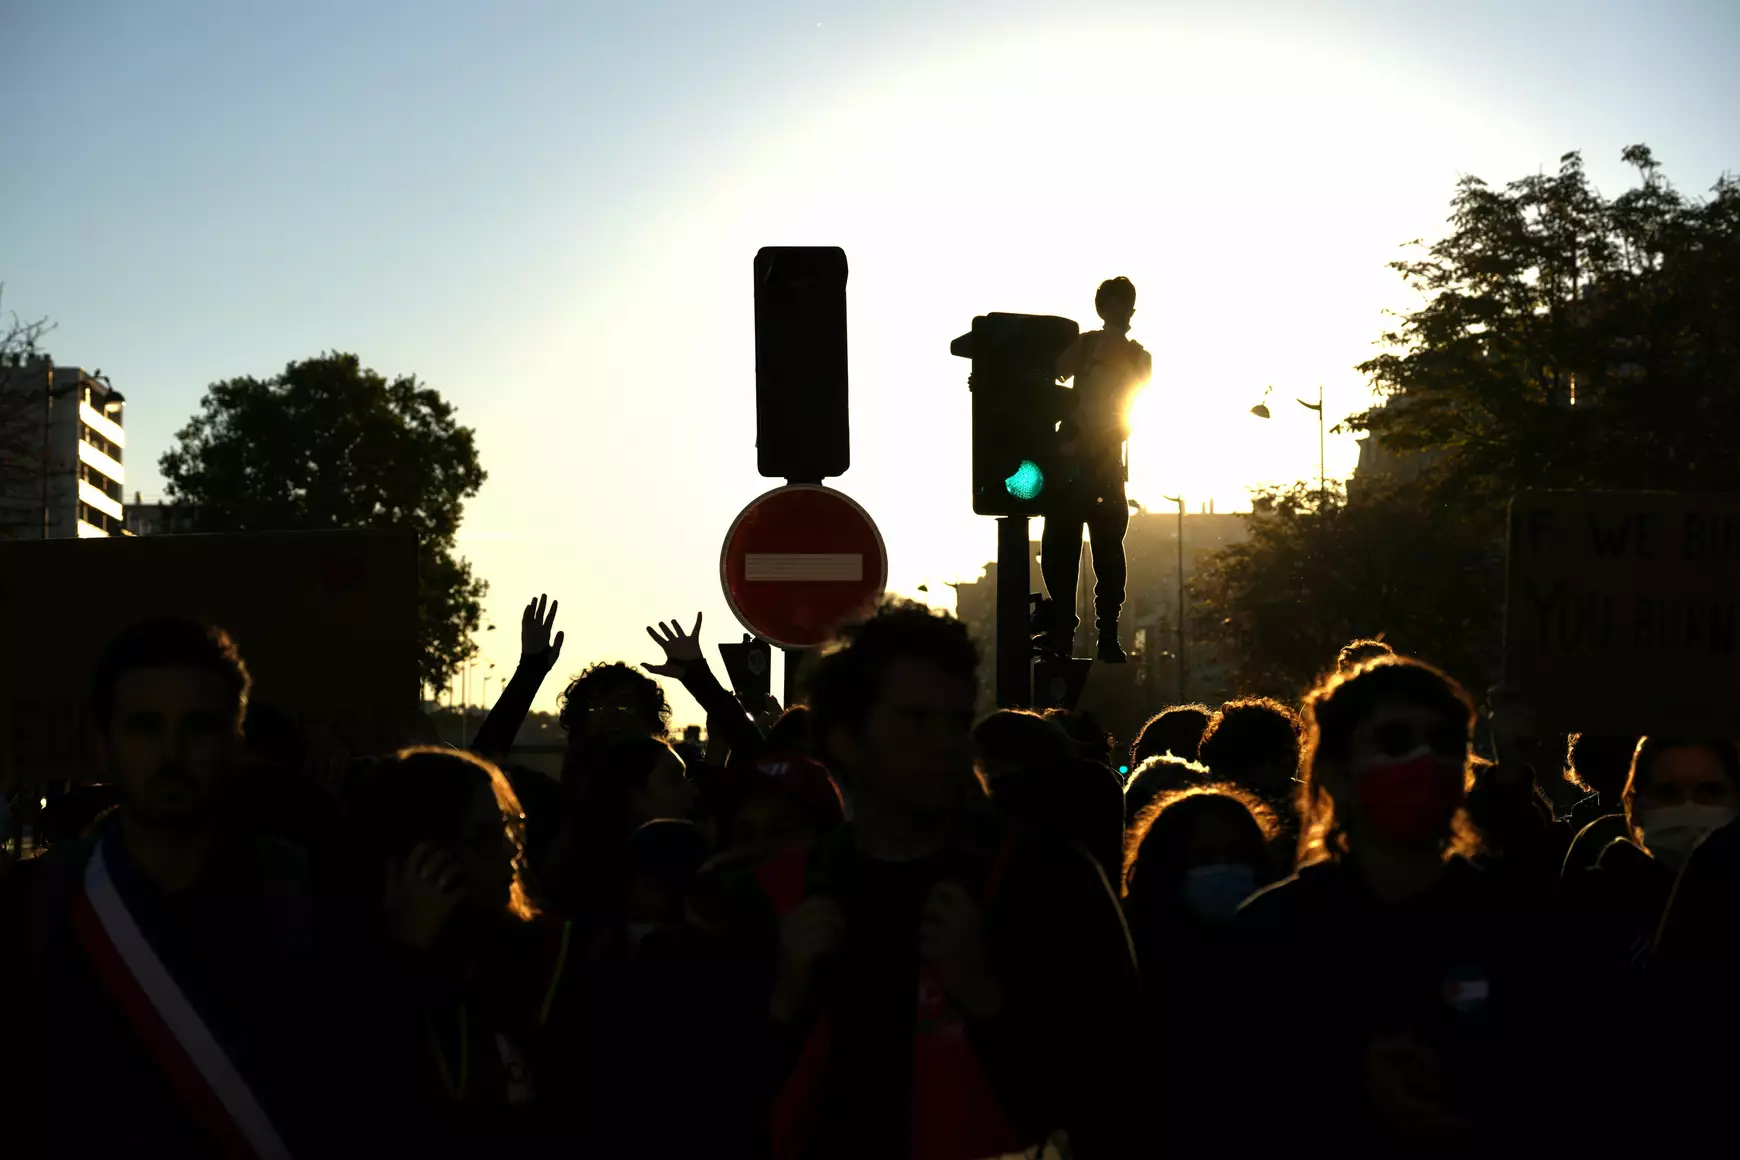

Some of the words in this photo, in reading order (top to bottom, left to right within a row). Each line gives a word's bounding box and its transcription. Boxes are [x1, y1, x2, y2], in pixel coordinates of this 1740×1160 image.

[1513, 509, 1556, 556] IF
[1587, 511, 1658, 559] WE
[1683, 512, 1740, 561] BU
[1525, 577, 1616, 655] YOU
